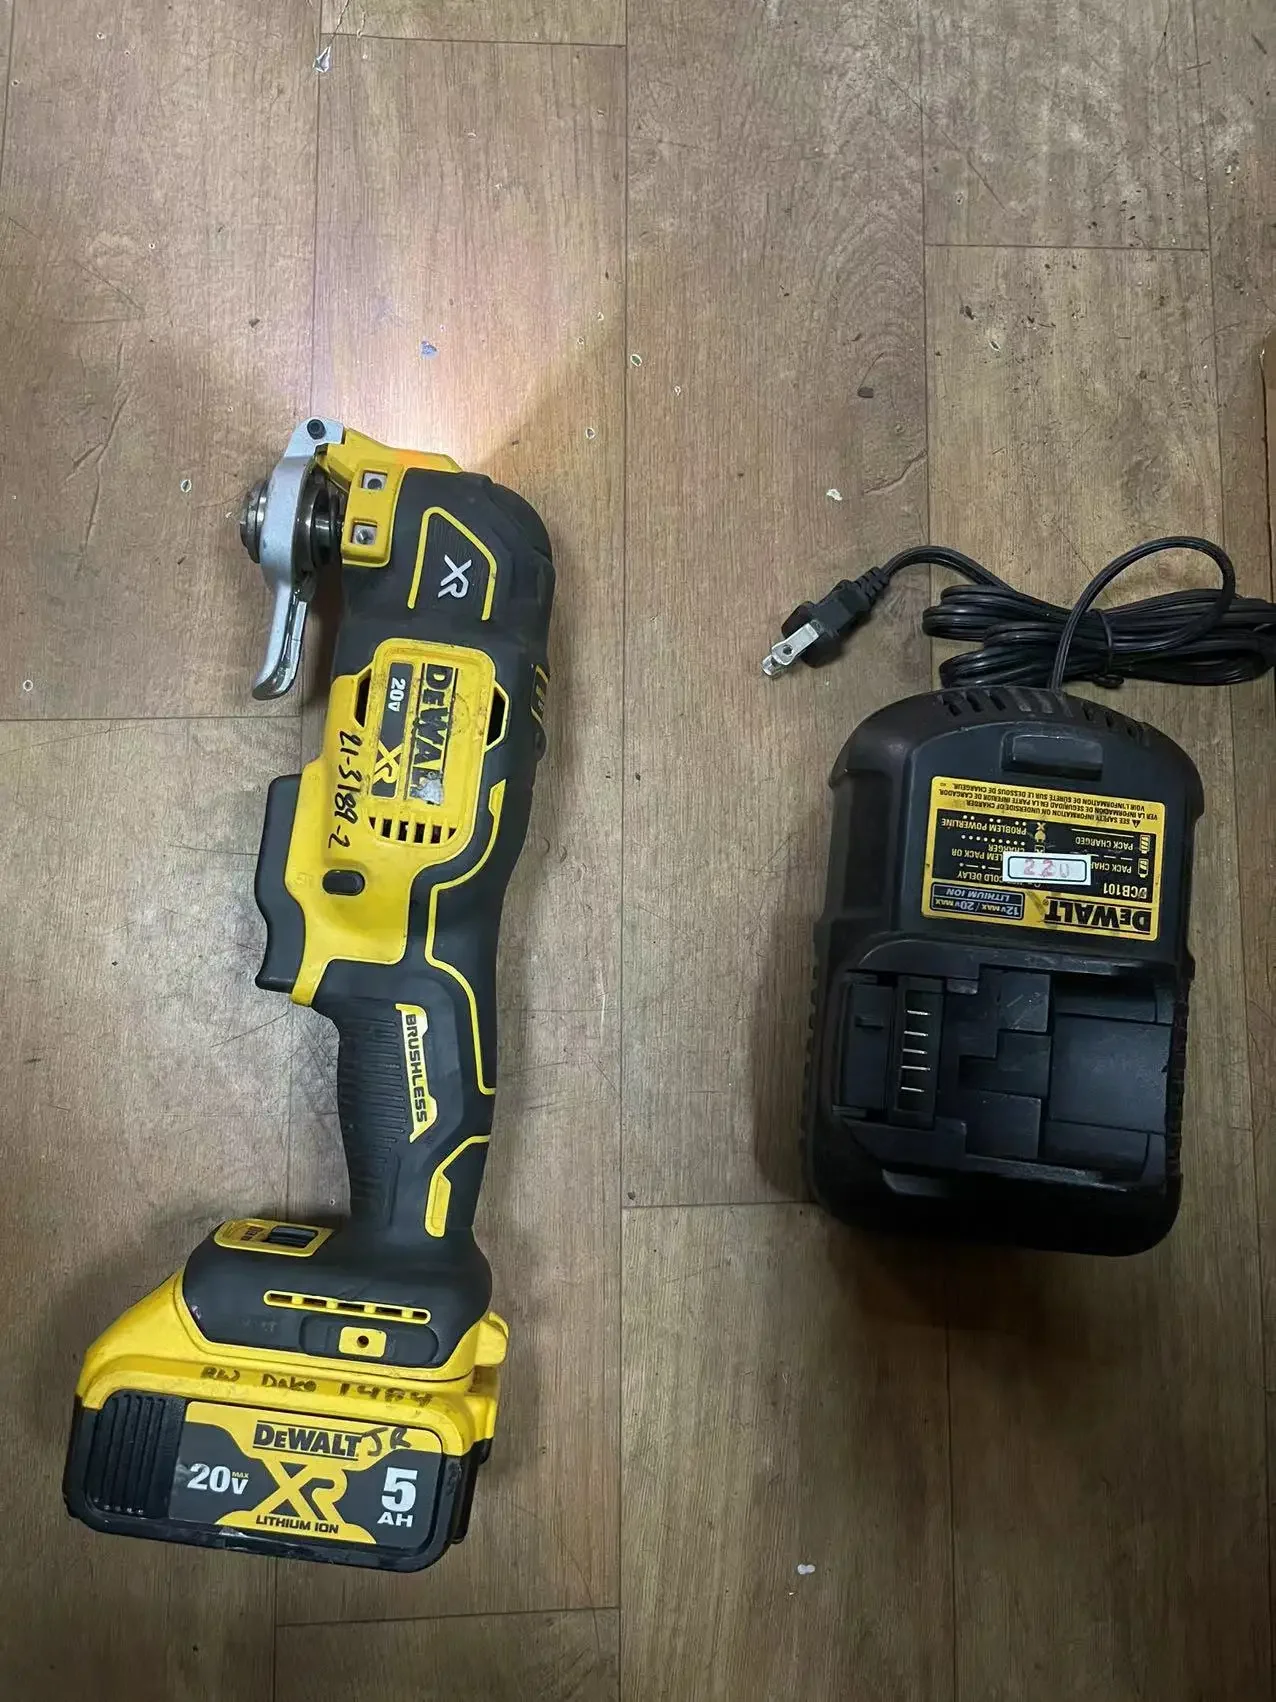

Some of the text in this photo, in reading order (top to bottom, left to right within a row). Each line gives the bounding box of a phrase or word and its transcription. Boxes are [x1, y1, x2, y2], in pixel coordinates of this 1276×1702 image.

[438, 554, 472, 598] XR
[409, 664, 454, 805] DEWAL
[998, 789, 1026, 797] DESSOUS
[1006, 804, 1040, 814] UNDERSIDE
[1050, 802, 1084, 812] SEGURIDAD
[1052, 810, 1094, 820] INFORMATION
[941, 818, 1027, 836] PROBLEM POWERLINE
[1075, 836, 1133, 850] PACK CHARGED
[951, 848, 963, 856] OR
[964, 850, 984, 860] PACK
[956, 870, 981, 880] DELAY
[1112, 864, 1132, 873] PACK
[946, 888, 1010, 901] LITHIUM ION
[1103, 883, 1147, 899] DCB101
[1045, 901, 1151, 932] DEWALT
[406, 1014, 428, 1122] BRUSHLESS
[254, 1422, 362, 1458] DEWALT
[232, 1471, 249, 1479] MAX
[381, 1466, 418, 1512] 5
[256, 1514, 339, 1534] LITHIUM ION
[377, 1511, 413, 1528] AH
